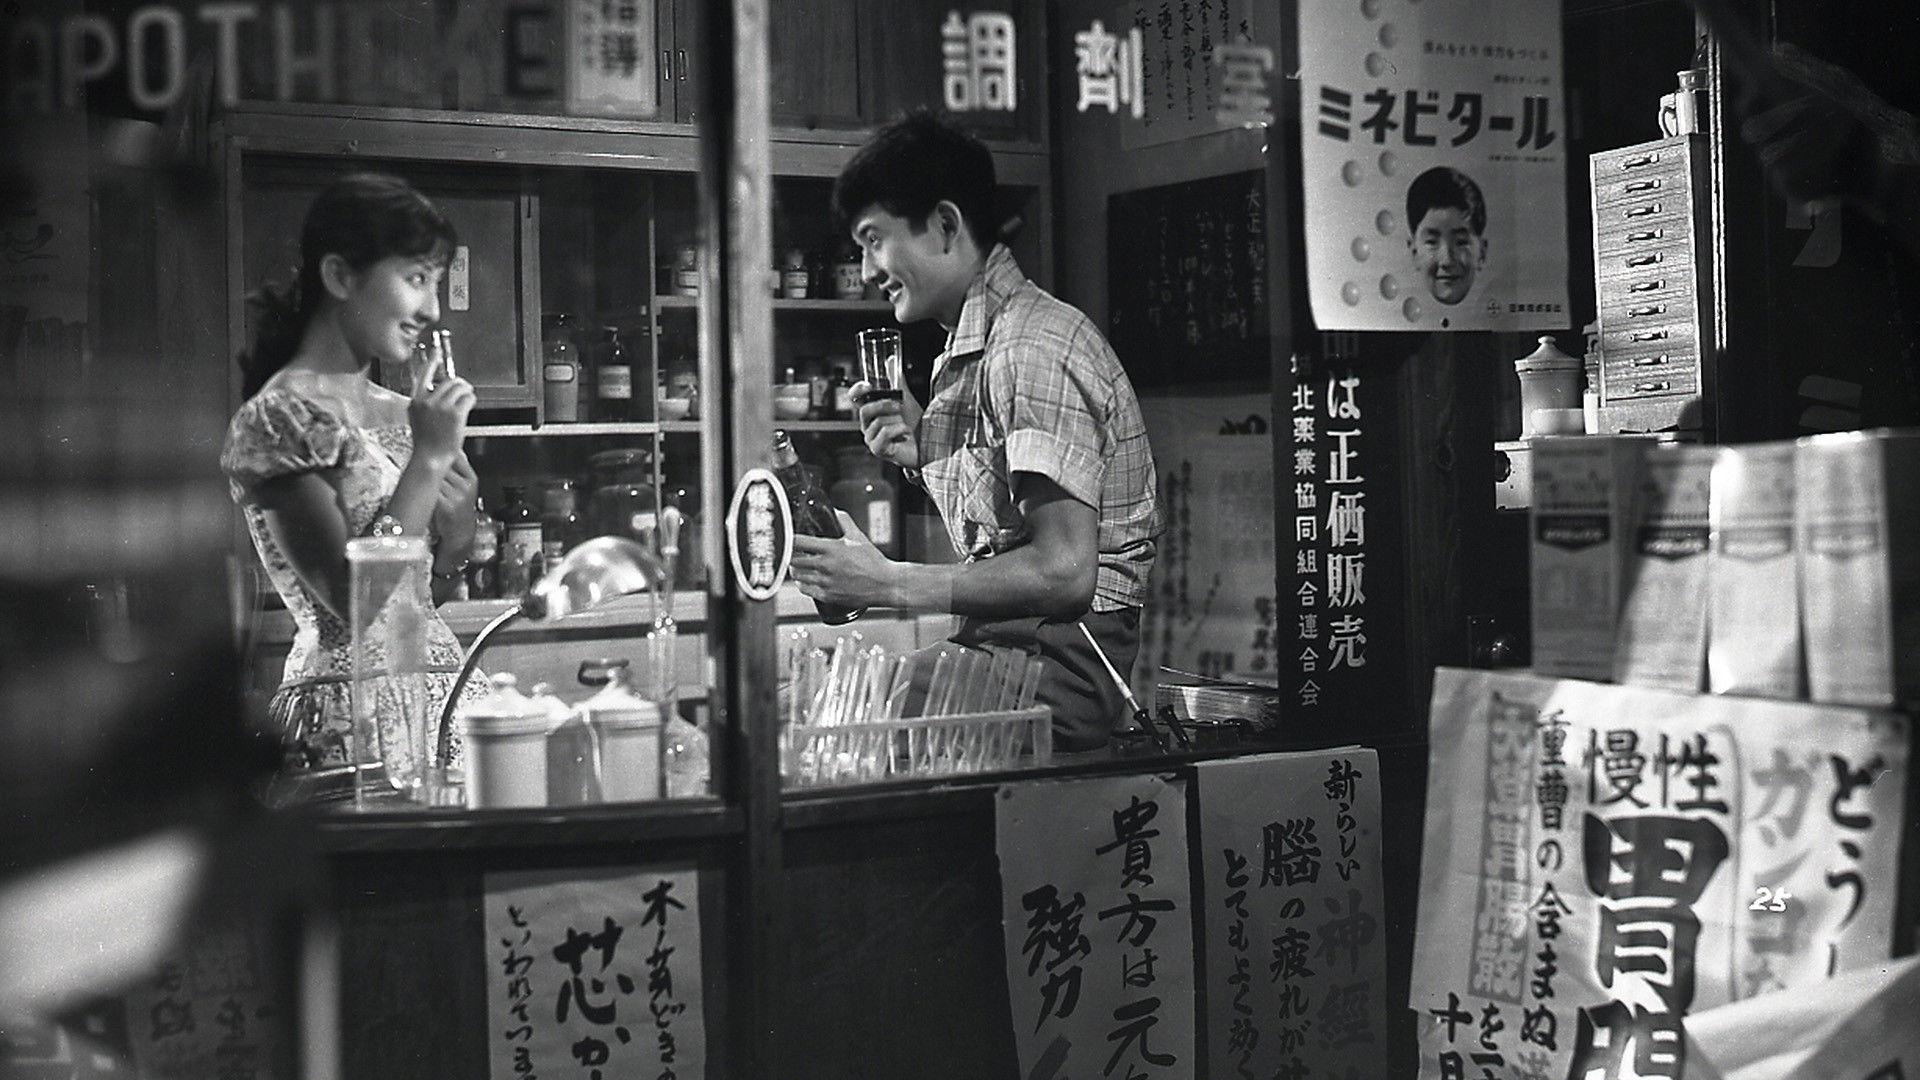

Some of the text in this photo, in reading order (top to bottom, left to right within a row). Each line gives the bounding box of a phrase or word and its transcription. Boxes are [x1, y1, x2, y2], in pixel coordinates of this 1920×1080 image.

[1318, 85, 1557, 151] ミネビタール
[1583, 728, 1729, 813] 慢性
[552, 916, 635, 1080] 芯か
[1469, 1000, 1506, 1080] を一
